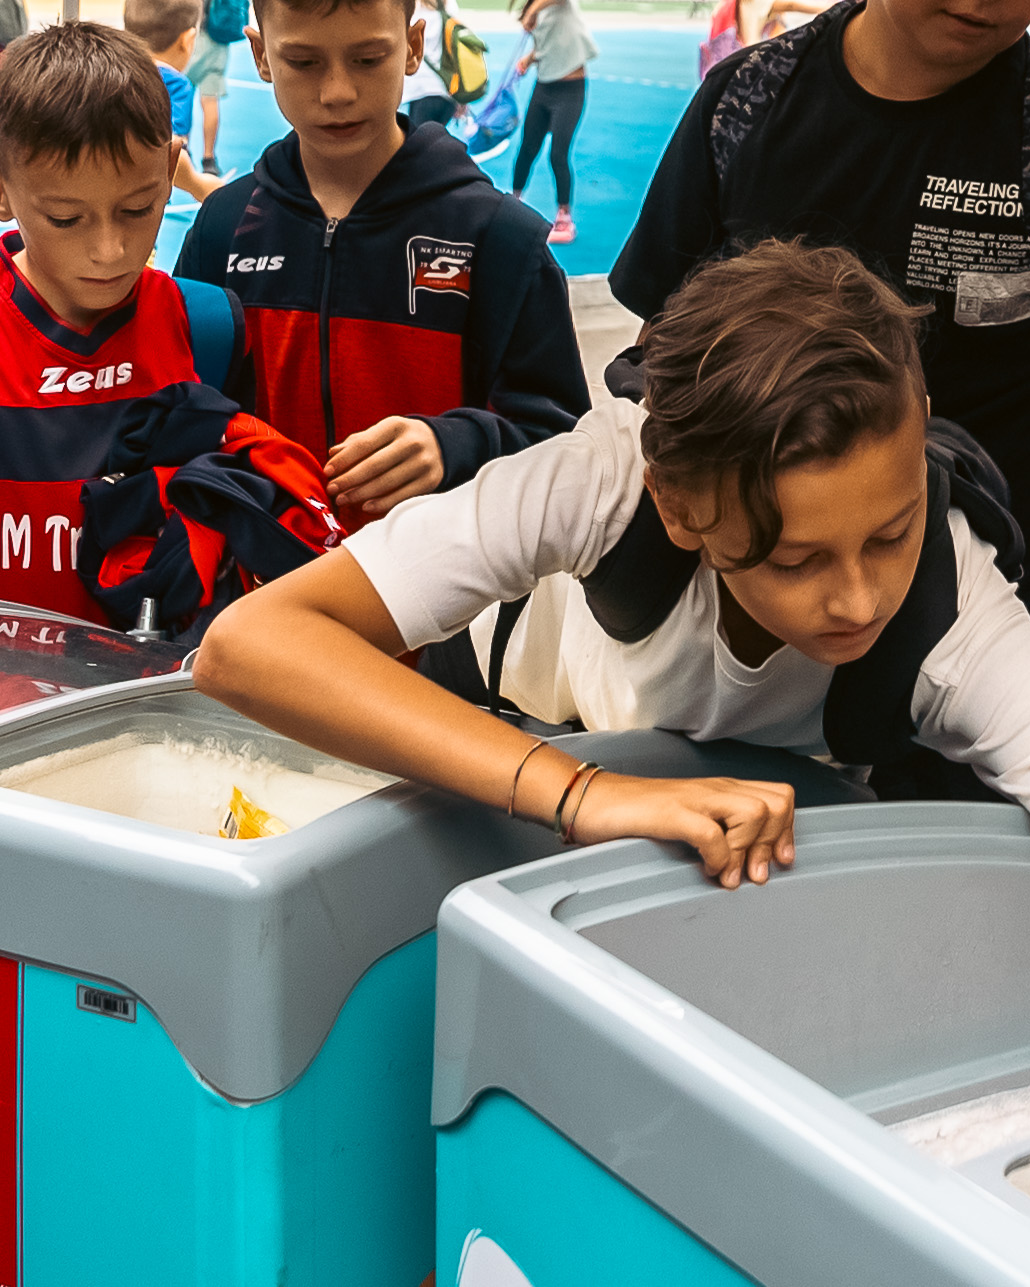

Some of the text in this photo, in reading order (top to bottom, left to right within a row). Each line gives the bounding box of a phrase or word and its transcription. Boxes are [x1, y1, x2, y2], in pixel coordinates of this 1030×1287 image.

[926, 175, 1020, 200] TRAVELING
[912, 231, 949, 243] BROADENS
[914, 223, 949, 235] TRAVELING
[953, 228, 976, 238] OPENS
[979, 232, 995, 240] NEW
[998, 234, 1023, 242] DOORS
[910, 239, 926, 248] INTO
[909, 247, 931, 256] LEARN
[934, 251, 949, 259] AND
[979, 256, 1019, 265] EXPLORING
[227, 253, 286, 273] Zeus
[907, 263, 921, 271] AND
[924, 265, 949, 275] TRYING
[937, 260, 968, 270] MEETING
[968, 263, 1007, 272] DIFFERENT
[906, 271, 940, 282] VALUABLE
[905, 279, 930, 288] WORLD
[931, 283, 945, 291] AND
[38, 362, 133, 394] Zeus
